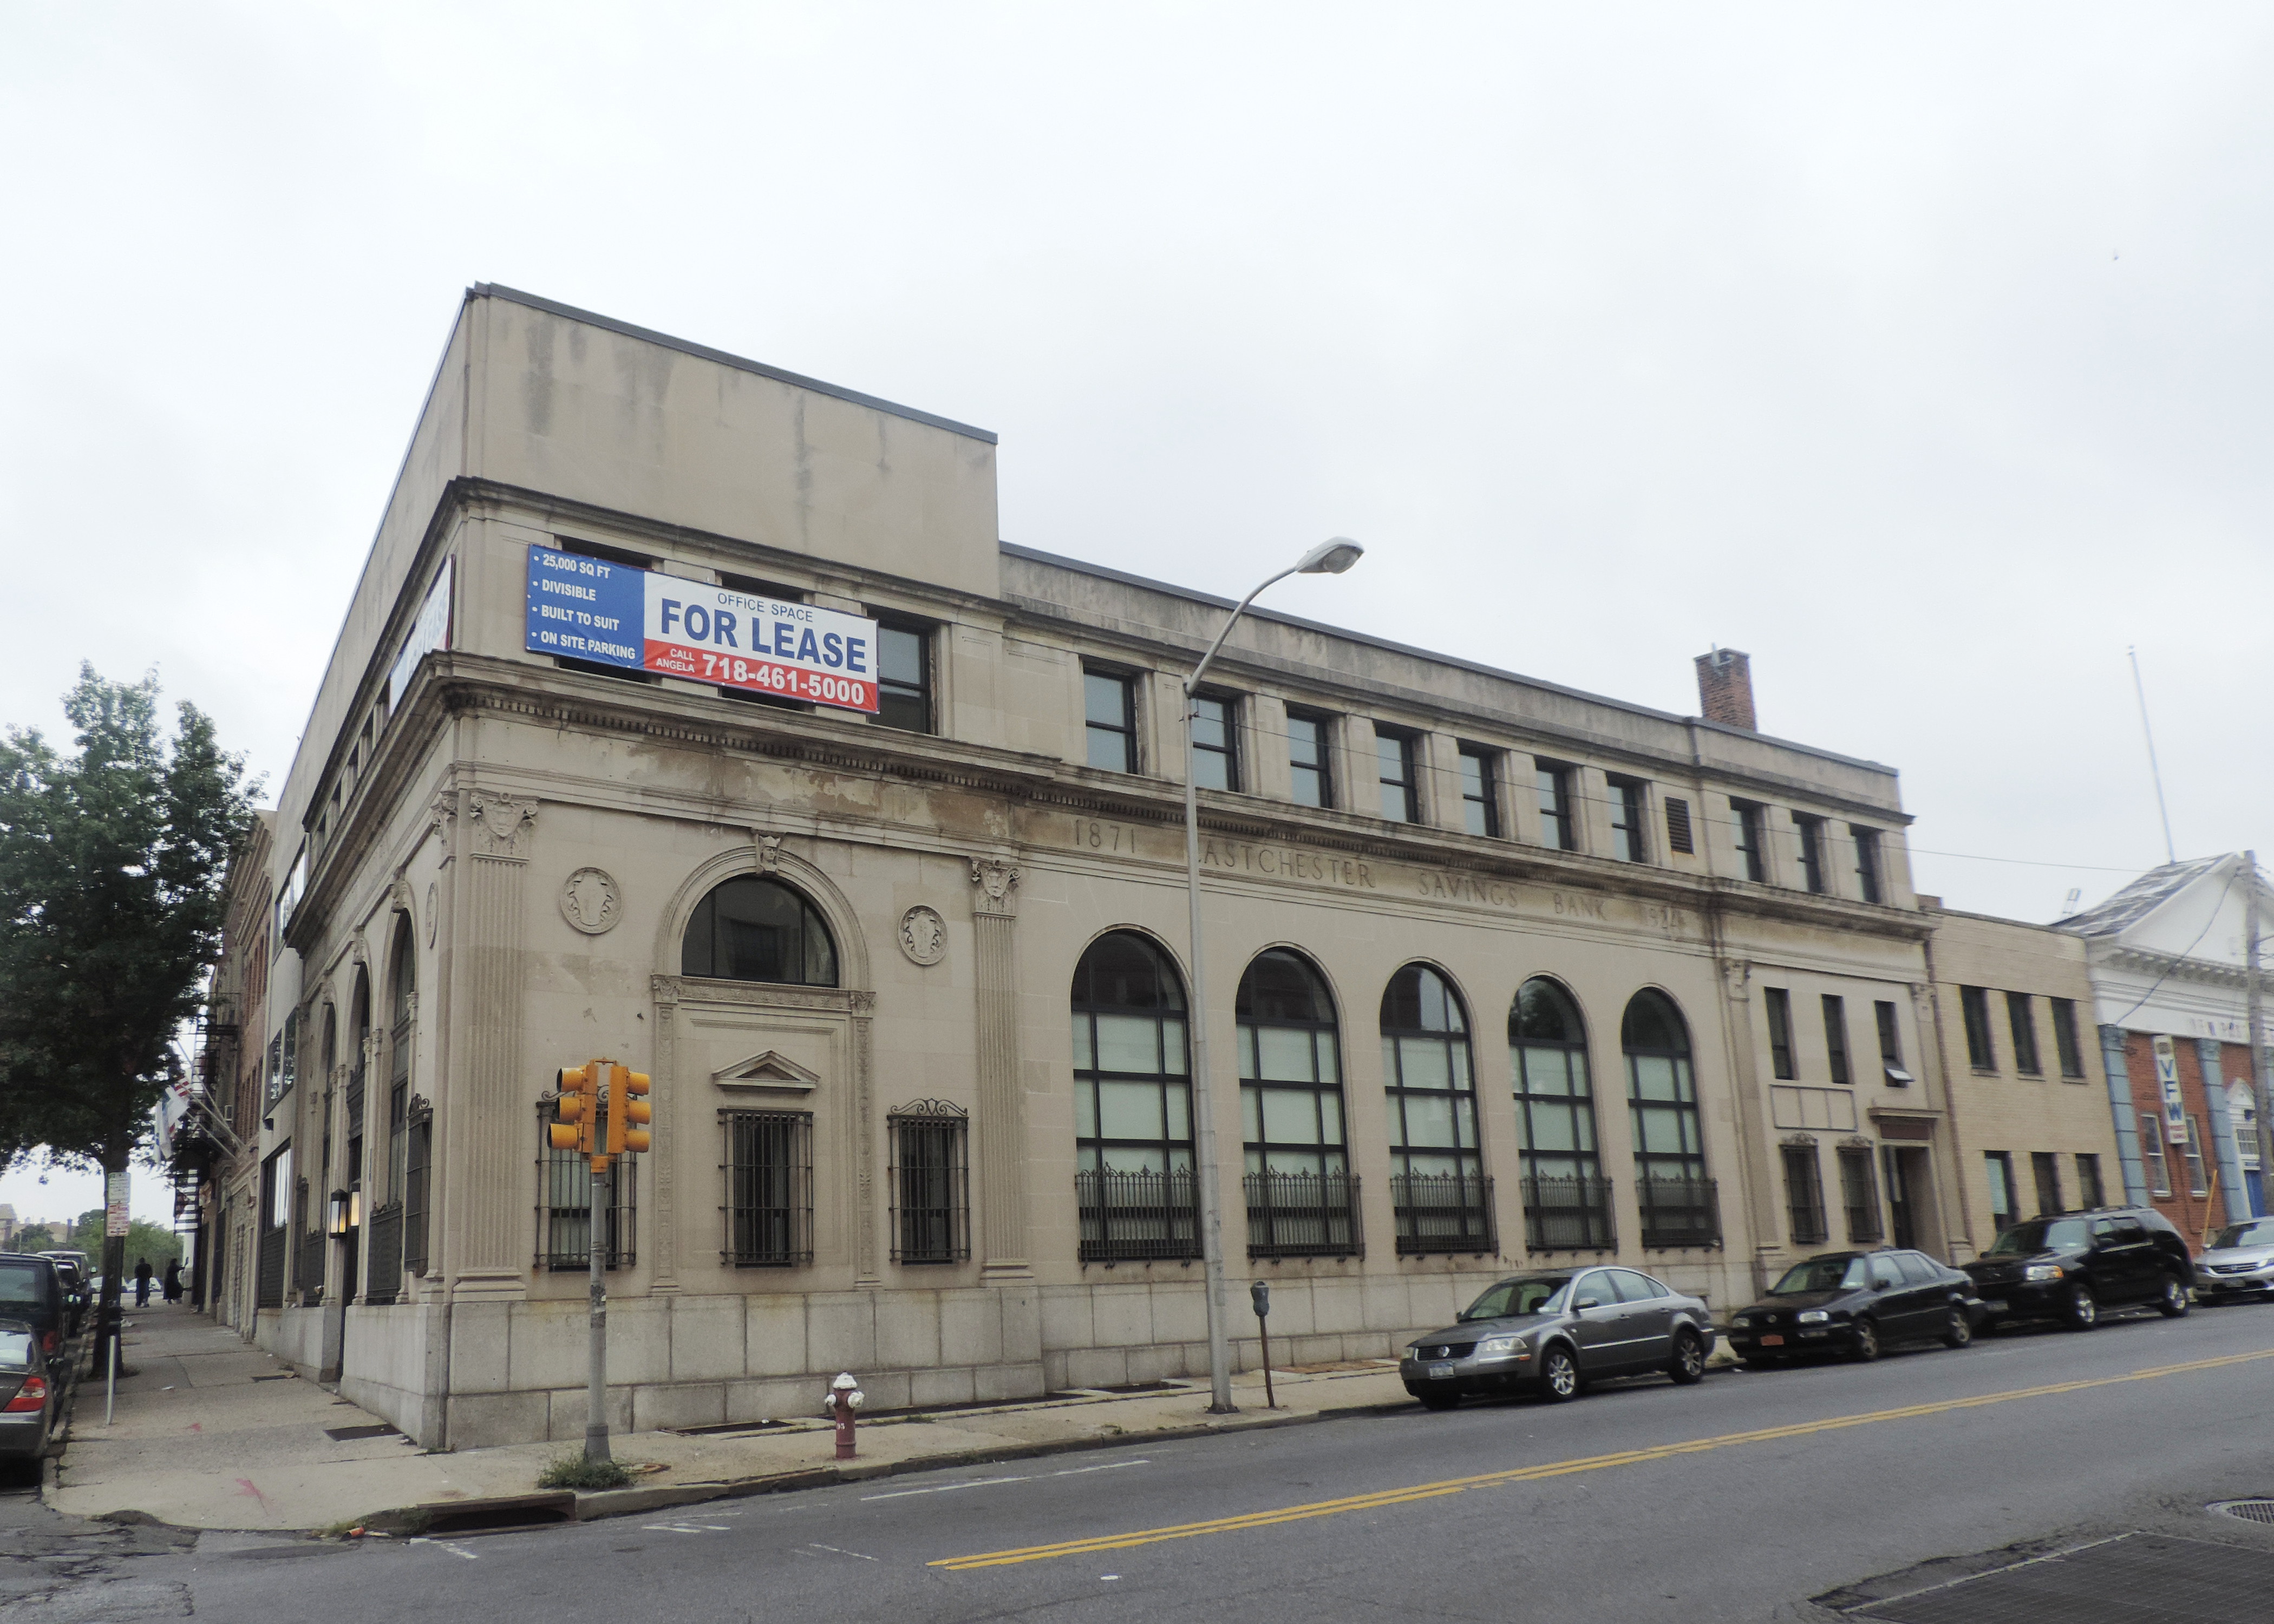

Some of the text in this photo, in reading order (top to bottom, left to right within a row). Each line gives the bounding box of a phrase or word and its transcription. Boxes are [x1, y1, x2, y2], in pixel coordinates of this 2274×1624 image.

[543, 554, 611, 579] 25,000 SQ FT
[542, 579, 596, 601] DIVISIBLE
[541, 605, 619, 631] BUILT TO SUIT
[717, 593, 813, 623] OFFICE SPACE
[541, 631, 636, 659] ON SITE PARKING
[662, 598, 866, 673] FOR LEASE
[656, 658, 695, 673] ANGELA
[670, 649, 695, 661] CALL
[703, 653, 865, 704] 718-461-5000
[1075, 819, 1134, 853] 1871
[1198, 840, 1376, 888] ASTCHESTER
[1419, 873, 1518, 908] SAVINGS
[1553, 893, 1607, 920] BANK
[2159, 1059, 2182, 1121] VFW
